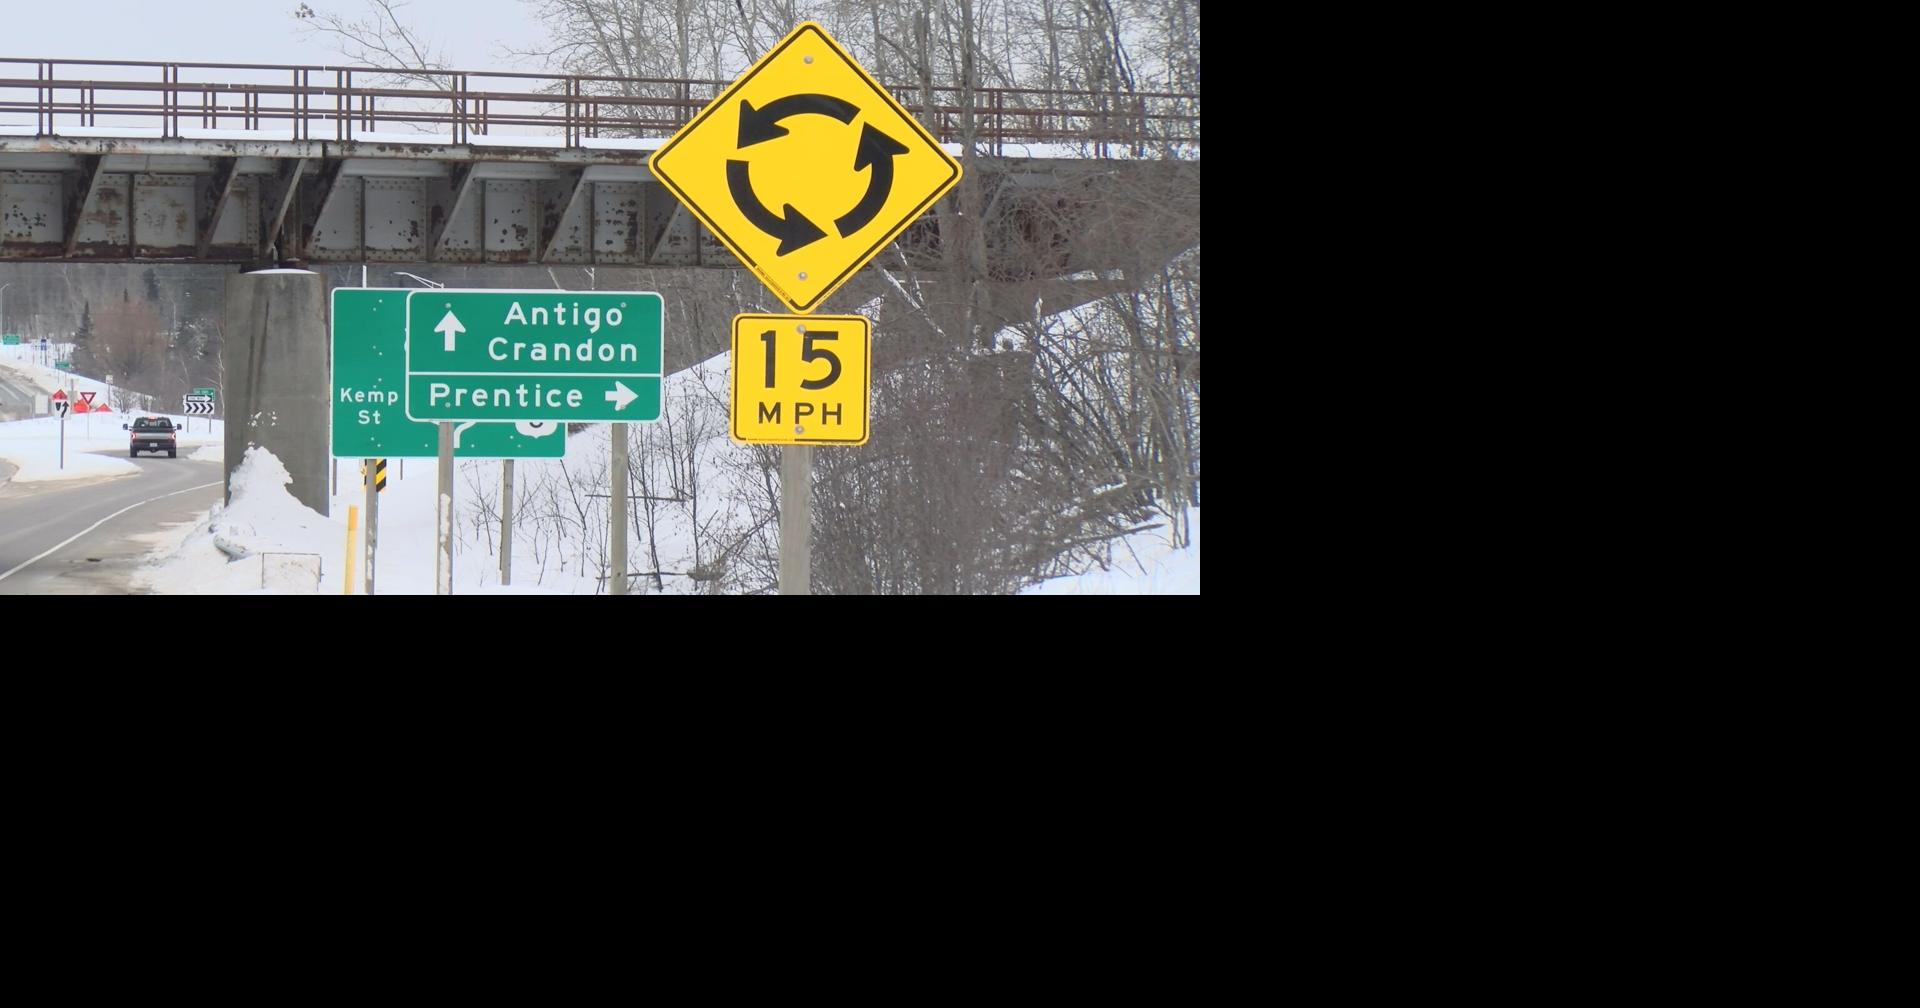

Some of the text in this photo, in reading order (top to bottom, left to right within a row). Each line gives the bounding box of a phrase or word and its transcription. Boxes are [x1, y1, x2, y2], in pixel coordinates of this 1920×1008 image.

[503, 301, 623, 334] Antigo
[487, 336, 638, 362] Crandon
[760, 330, 842, 390] 15
[340, 387, 399, 406] Kemp
[429, 383, 584, 408] Prentice
[357, 409, 381, 425] St
[757, 401, 842, 425] MPH
